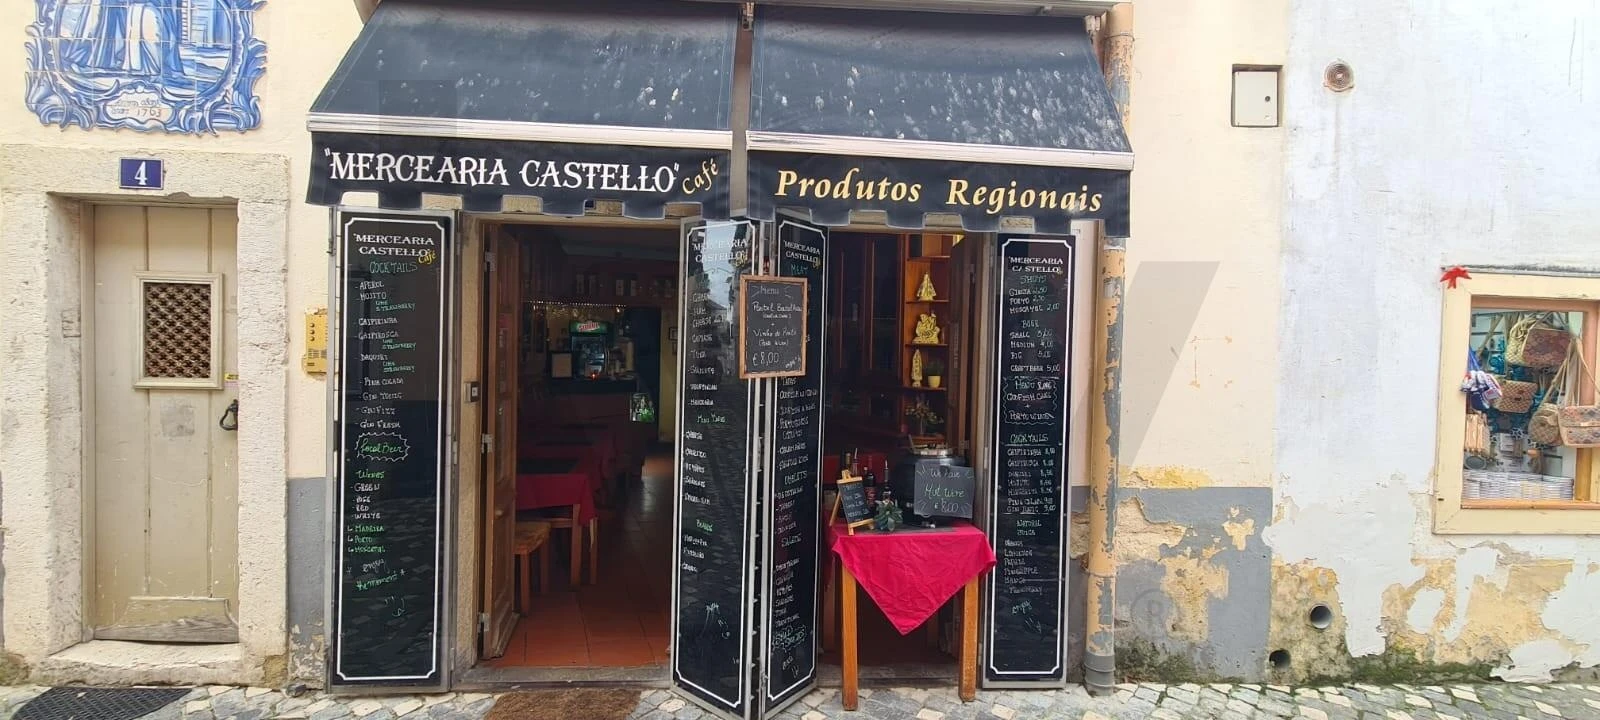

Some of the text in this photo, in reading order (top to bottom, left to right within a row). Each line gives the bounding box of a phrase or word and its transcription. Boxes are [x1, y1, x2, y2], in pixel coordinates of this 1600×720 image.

[134, 161, 147, 186] 4
[324, 147, 719, 195] "MERCEARIA CASTELLO" Café
[774, 167, 1103, 215] Produtos Regionais
